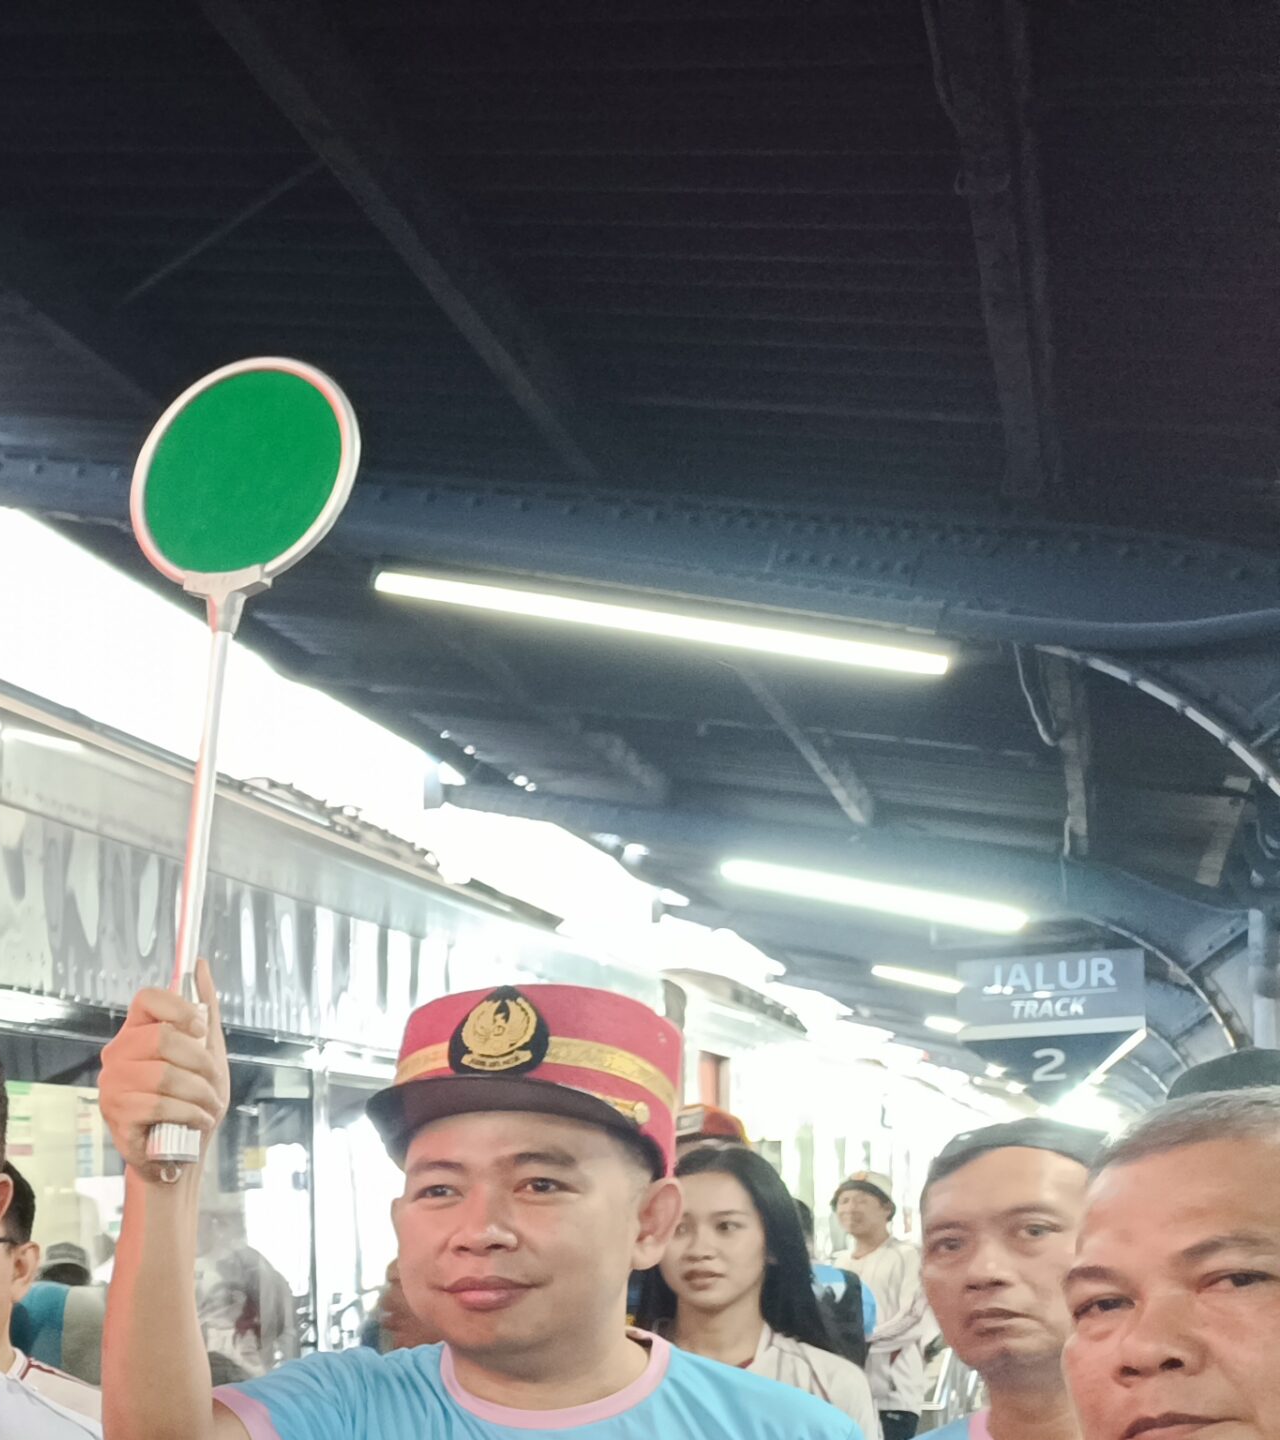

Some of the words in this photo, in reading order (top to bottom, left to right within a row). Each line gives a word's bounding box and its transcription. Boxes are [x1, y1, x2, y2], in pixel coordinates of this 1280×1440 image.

[990, 957, 1117, 993] JALUR
[1011, 996, 1087, 1020] TRACK
[1032, 1048, 1067, 1082] 2
